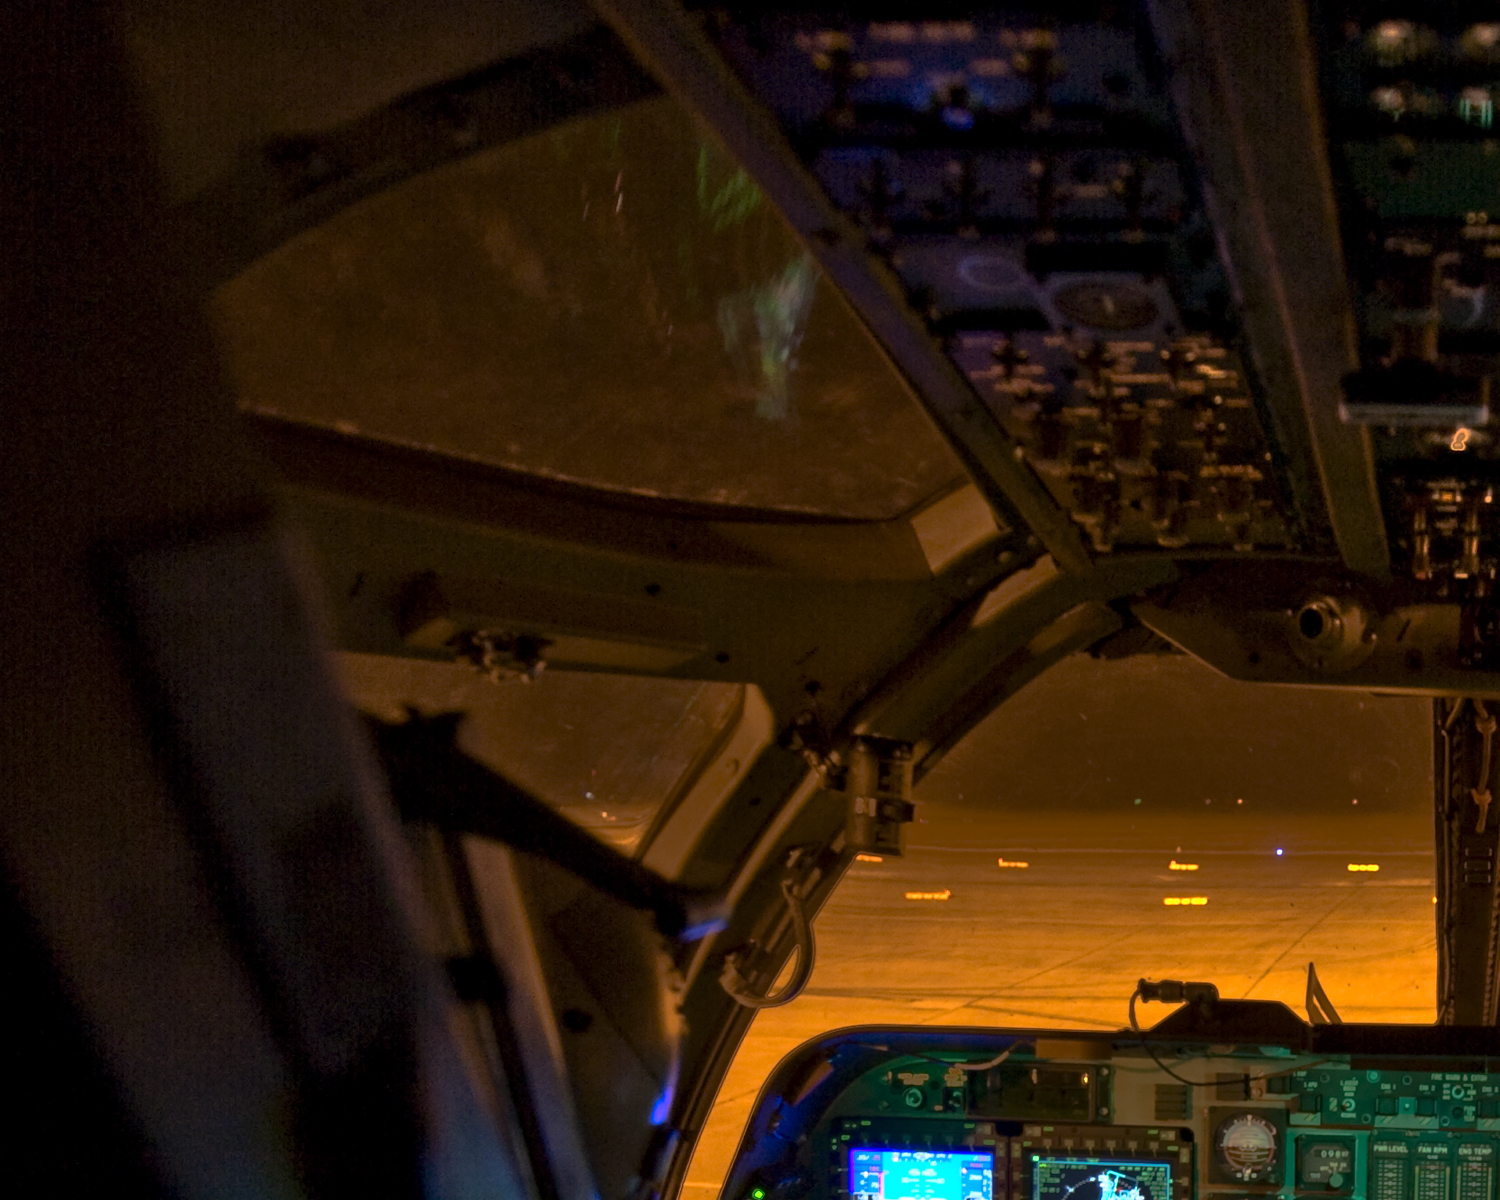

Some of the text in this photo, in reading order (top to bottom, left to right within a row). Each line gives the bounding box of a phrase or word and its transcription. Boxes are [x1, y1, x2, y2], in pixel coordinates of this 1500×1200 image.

[1374, 1145, 1409, 1154] PWR LEVEL
[1417, 1146, 1431, 1154] FAN
[1458, 1147, 1492, 1155] ENG TEMP
